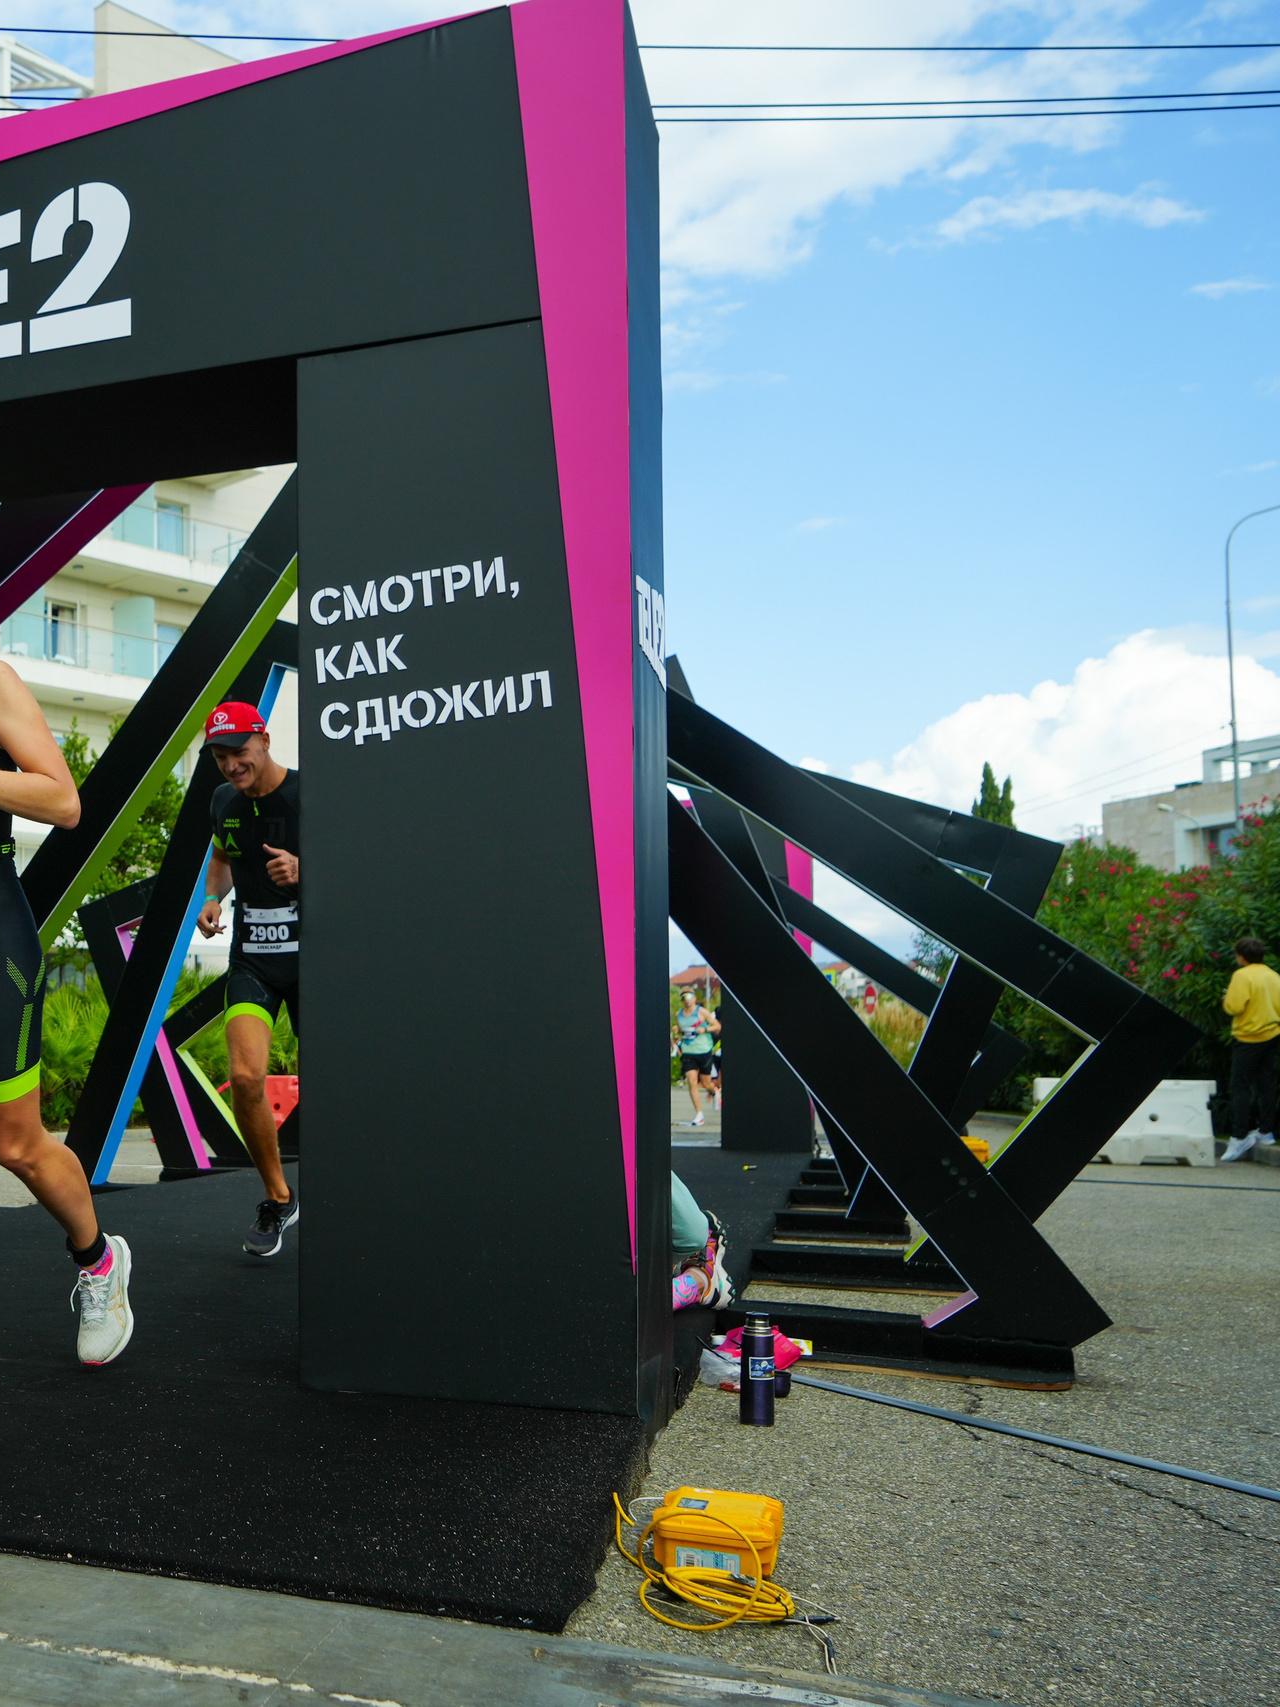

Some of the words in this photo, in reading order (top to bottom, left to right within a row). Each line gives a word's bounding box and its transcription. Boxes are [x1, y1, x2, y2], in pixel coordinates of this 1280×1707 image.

[309, 556, 520, 626] СМОТРИ,
[315, 634, 408, 684] КАК
[320, 670, 553, 746] СДЮЖИЛ
[249, 924, 290, 941] 2900
